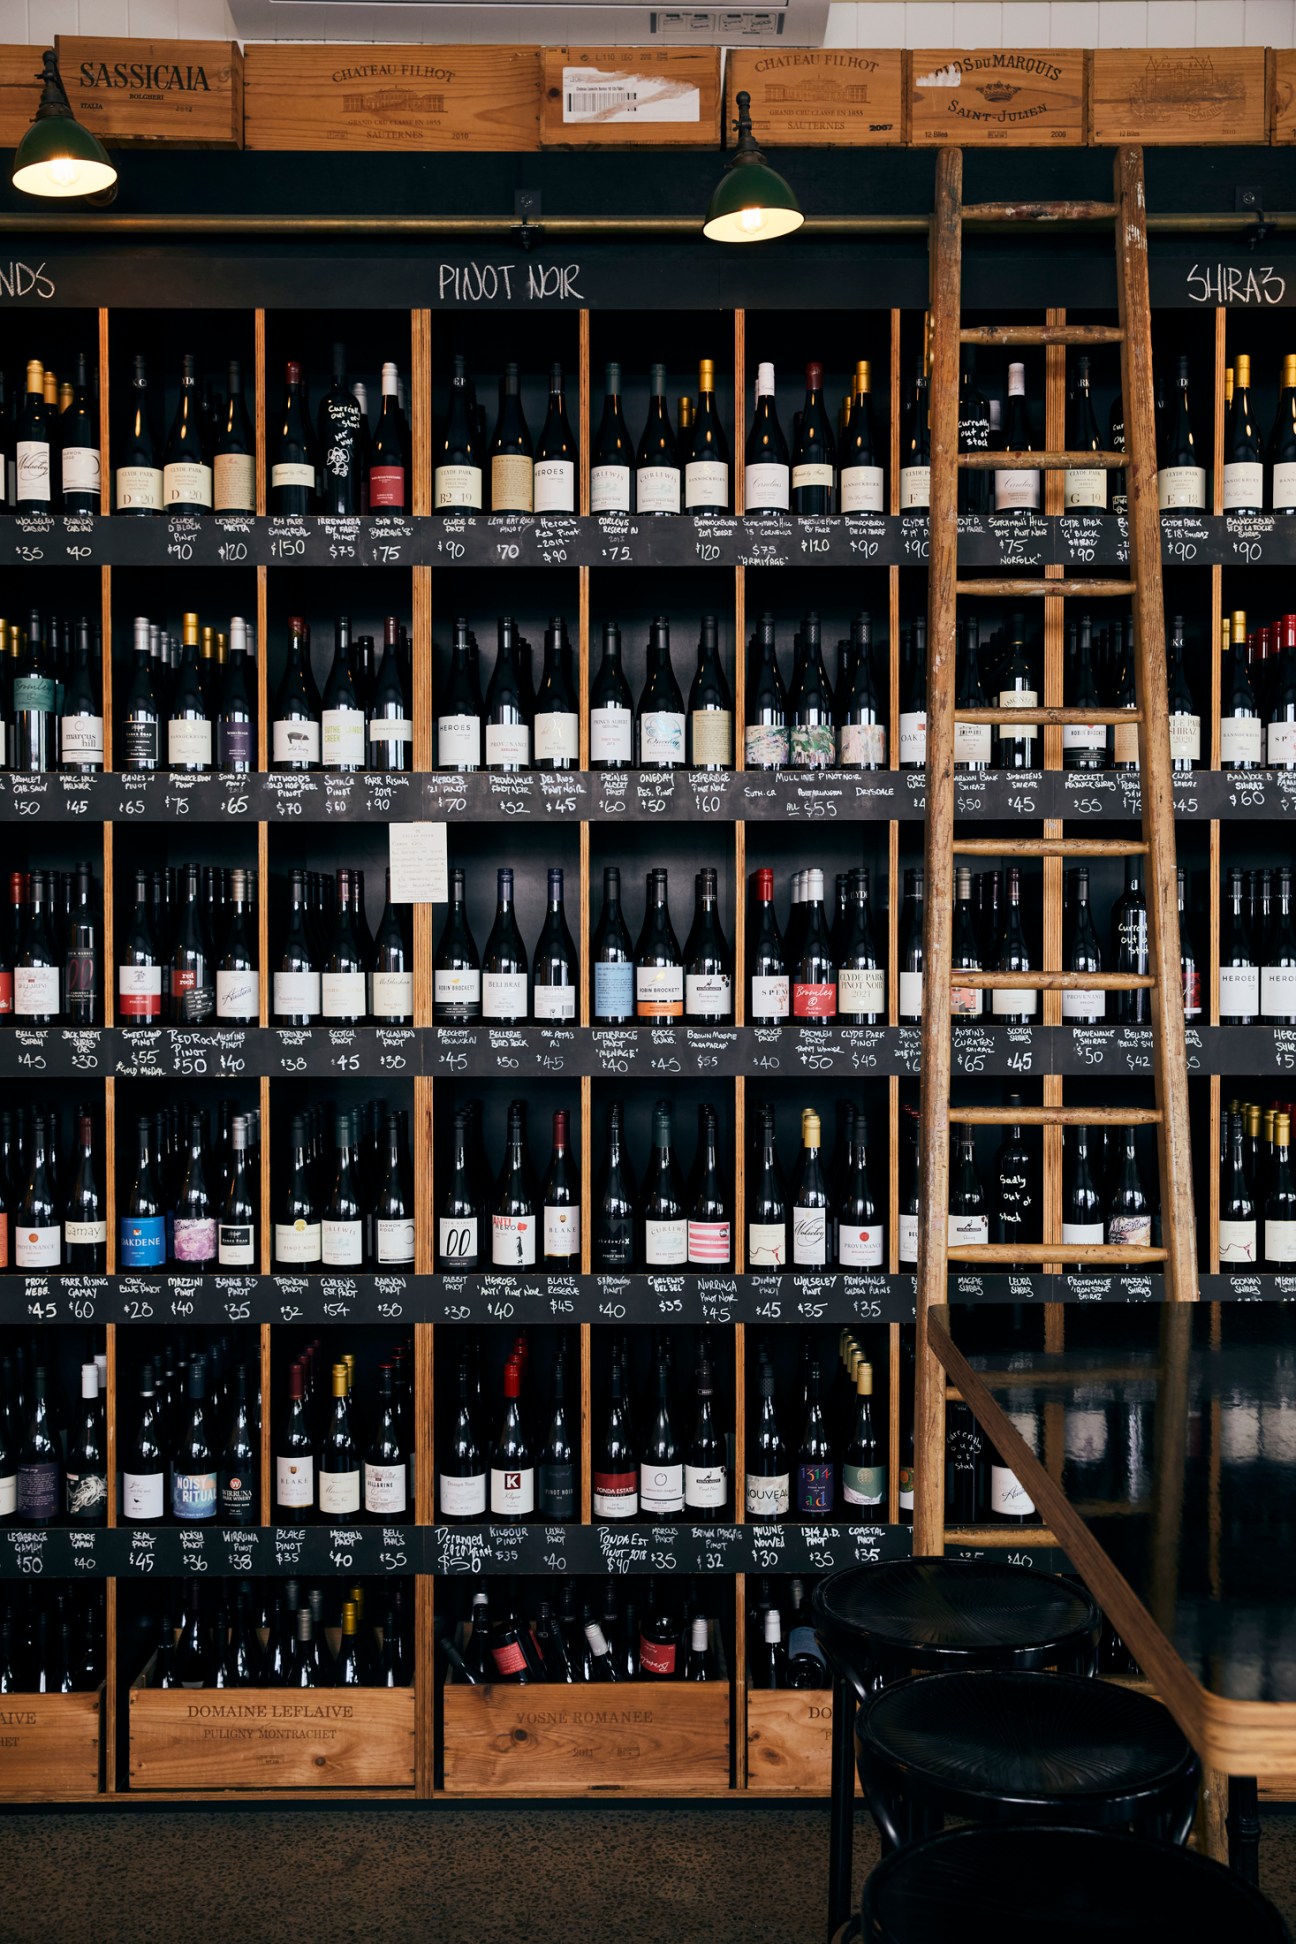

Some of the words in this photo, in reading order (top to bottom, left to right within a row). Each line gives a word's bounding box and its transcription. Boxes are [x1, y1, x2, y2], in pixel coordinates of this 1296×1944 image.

[755, 55, 820, 72] CHATEAU
[825, 55, 879, 73] FILHOT
[975, 59, 990, 69] DU
[993, 54, 1062, 80] MARQUIS
[80, 62, 211, 91] SASSICAIA
[332, 65, 396, 82] CHATEAU
[402, 65, 455, 82] FILHOT
[439, 262, 515, 300] PINOT
[529, 264, 584, 300] NOIR
[172, 489, 179, 499] D
[1071, 494, 1079, 503] G
[1168, 496, 1175, 505] E
[168, 544, 192, 560] $90
[438, 541, 465, 559] $90
[497, 545, 520, 559] $70
[850, 540, 878, 559] $90
[999, 539, 1029, 554] $75
[1168, 542, 1197, 561] $90
[1233, 542, 1262, 563] $90
[901, 734, 917, 742] OAK
[640, 773, 674, 786] ONEDAY
[221, 796, 249, 814] $65
[642, 800, 665, 812] $50
[696, 796, 720, 812] $60
[957, 798, 981, 812] $50
[1229, 791, 1265, 807] $60
[14, 800, 40, 815] $50
[67, 800, 88, 814] $45
[276, 802, 302, 815] $70
[804, 801, 837, 818] $55
[796, 985, 833, 998] Bromley
[866, 1030, 885, 1039] PARK
[851, 1040, 878, 1048] PINOT
[173, 1058, 207, 1075] $50
[851, 1052, 877, 1069] $45
[957, 1054, 986, 1072] $65
[1000, 1174, 1026, 1188] Sadly
[1003, 1192, 1020, 1201] out
[493, 1217, 512, 1225] ANTI
[66, 1224, 100, 1238] Gamay
[121, 1237, 160, 1247] OAKDENE
[60, 1278, 82, 1286] FARR
[484, 1276, 517, 1286] HEROES
[548, 1277, 576, 1286] BLAKE
[794, 1276, 837, 1286] WOLSELEY
[68, 1288, 97, 1299] GAMAY
[69, 1301, 94, 1319] $60
[124, 1302, 153, 1319] $28
[171, 1301, 194, 1317] $40
[488, 1302, 514, 1320] $40
[550, 1299, 574, 1314] $45
[599, 1302, 626, 1319] $40
[756, 1302, 782, 1318] $45
[798, 1303, 828, 1318] $35
[853, 1301, 882, 1317] $35
[177, 1477, 206, 1489] NOISY
[506, 1475, 519, 1488] K
[182, 1489, 217, 1503] RITUAL
[276, 1529, 306, 1540] BLAKE
[490, 1527, 529, 1537] KILGOUR
[496, 1537, 524, 1545] PINOT
[631, 1533, 649, 1546] EST
[276, 1542, 303, 1552] PINOT
[130, 1552, 155, 1571] $45
[183, 1555, 208, 1571] $36
[276, 1552, 299, 1565] $35
[495, 1551, 518, 1561] $35
[651, 1552, 677, 1569] $35
[16, 1556, 43, 1573] $50
[188, 1706, 267, 1718] DOMAINE
[272, 1705, 354, 1718] LEFLAIVE
[516, 1712, 568, 1724] VOSNE
[572, 1711, 654, 1724] ROMANEE
[203, 1729, 254, 1740] PULIGNY
[259, 1729, 337, 1740] MONTRACHET
